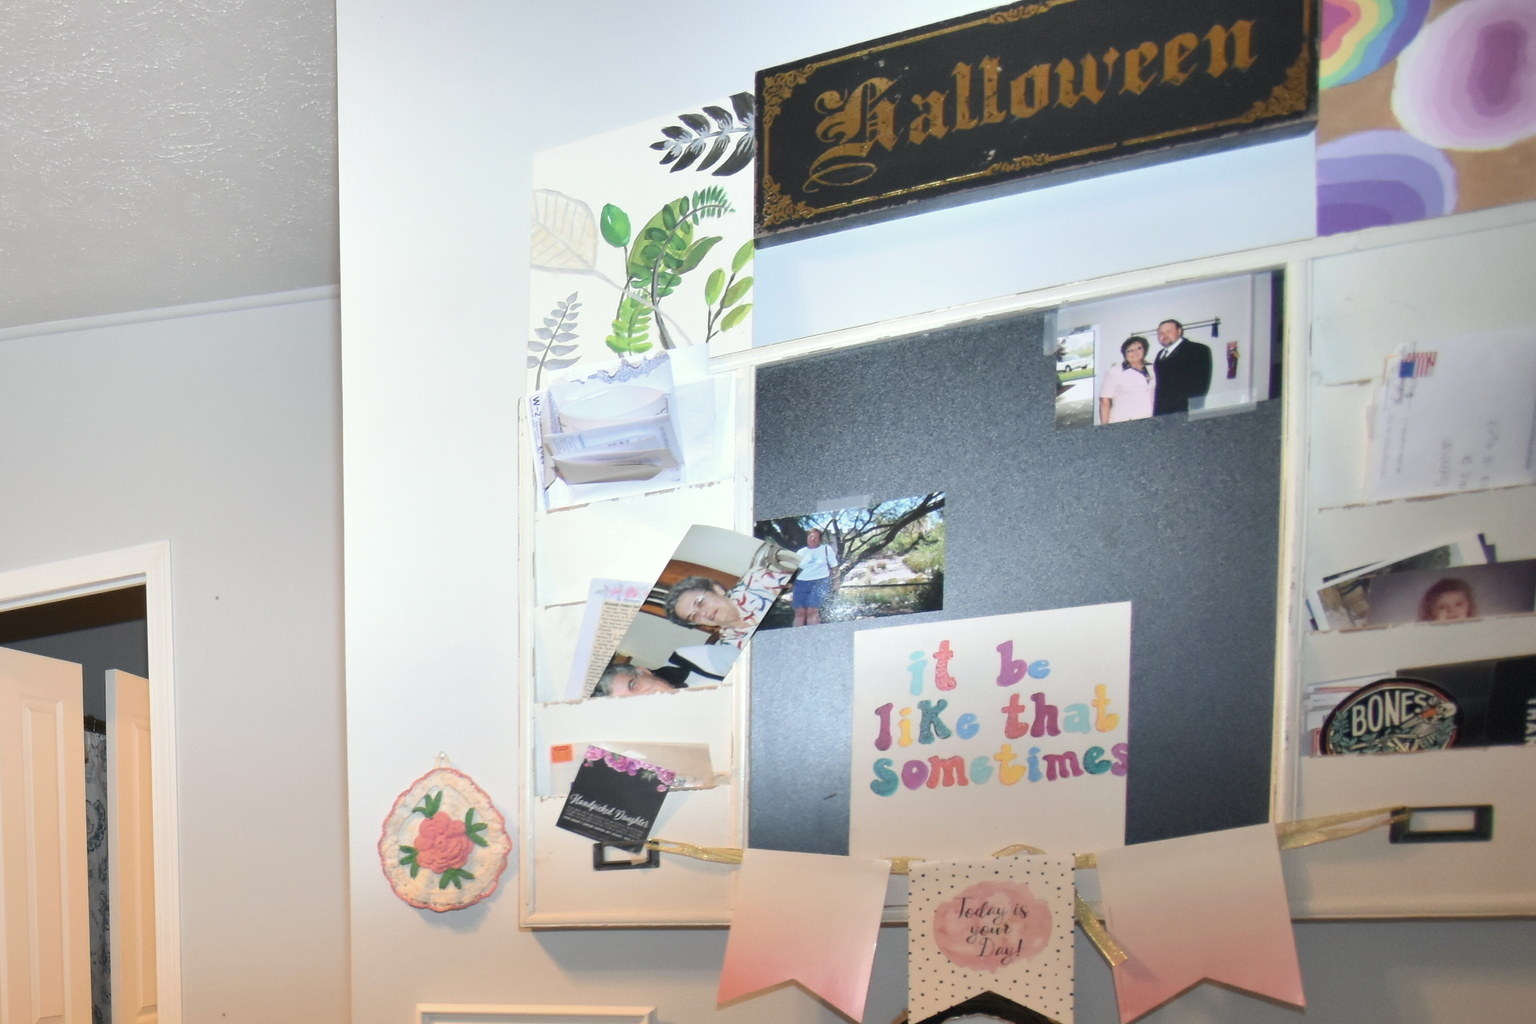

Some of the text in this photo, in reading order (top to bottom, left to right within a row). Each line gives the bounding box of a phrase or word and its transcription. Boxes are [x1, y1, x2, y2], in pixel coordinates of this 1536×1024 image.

[803, 19, 1264, 193] Halloween
[532, 396, 542, 417] W-2
[907, 640, 1051, 696] it be
[1001, 684, 1119, 739] that
[1352, 691, 1430, 737] BONES
[870, 742, 1129, 797] sometimes
[570, 793, 615, 816] Handpicked
[613, 809, 649, 828] Daughter
[953, 897, 1029, 925] Today is
[966, 923, 1012, 944] your
[976, 937, 1023, 965] Day!
